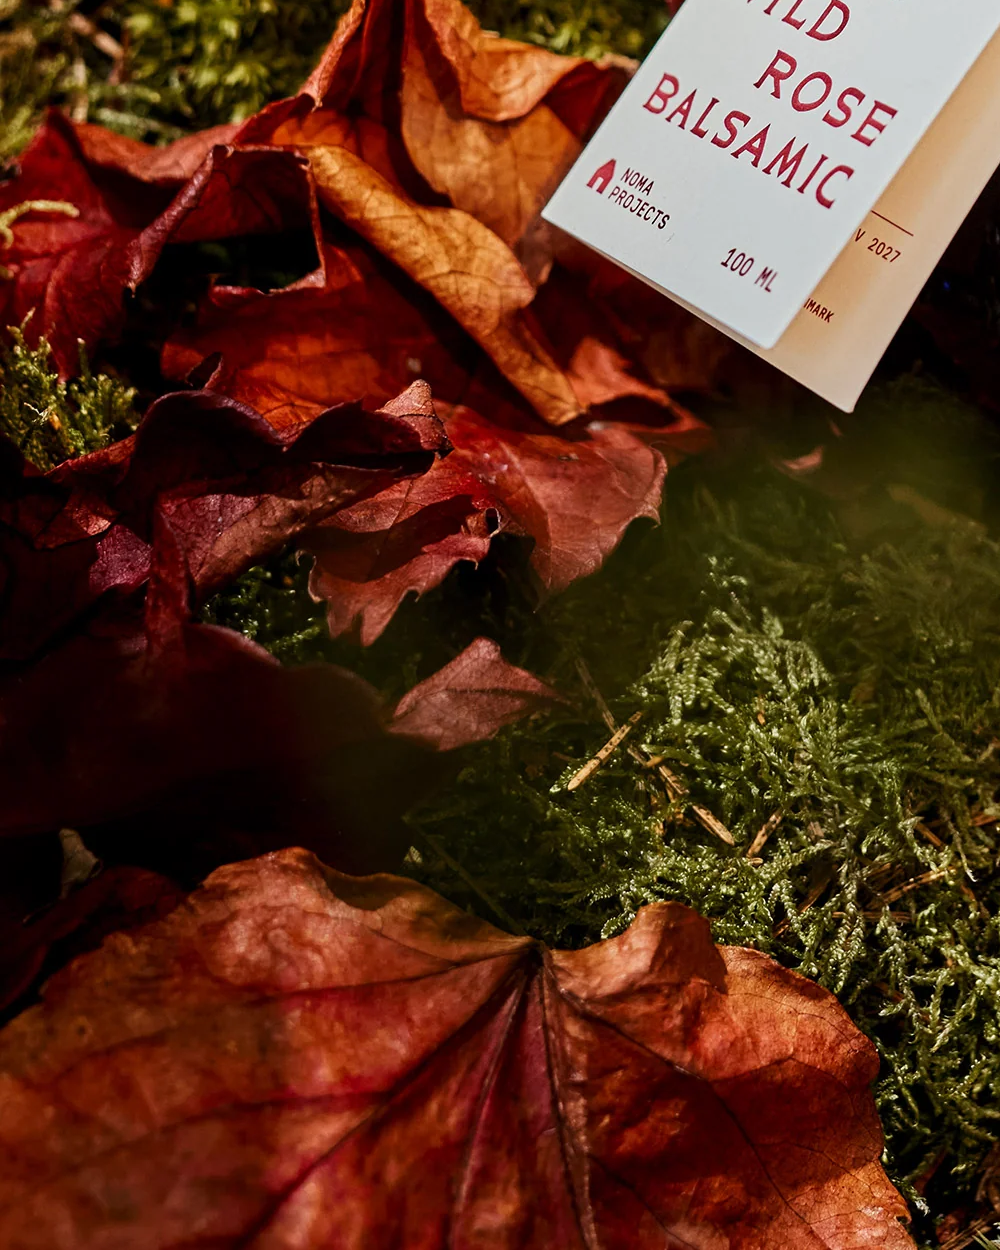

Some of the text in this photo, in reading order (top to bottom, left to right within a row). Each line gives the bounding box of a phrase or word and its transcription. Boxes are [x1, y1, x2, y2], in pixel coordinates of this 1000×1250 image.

[753, 49, 898, 147] ROSE
[642, 72, 855, 209] BALSAMIC
[620, 167, 655, 196] NOMA
[608, 186, 671, 230] PROJECTS
[720, 248, 778, 293] 100 ML
[867, 237, 902, 263] 2027
